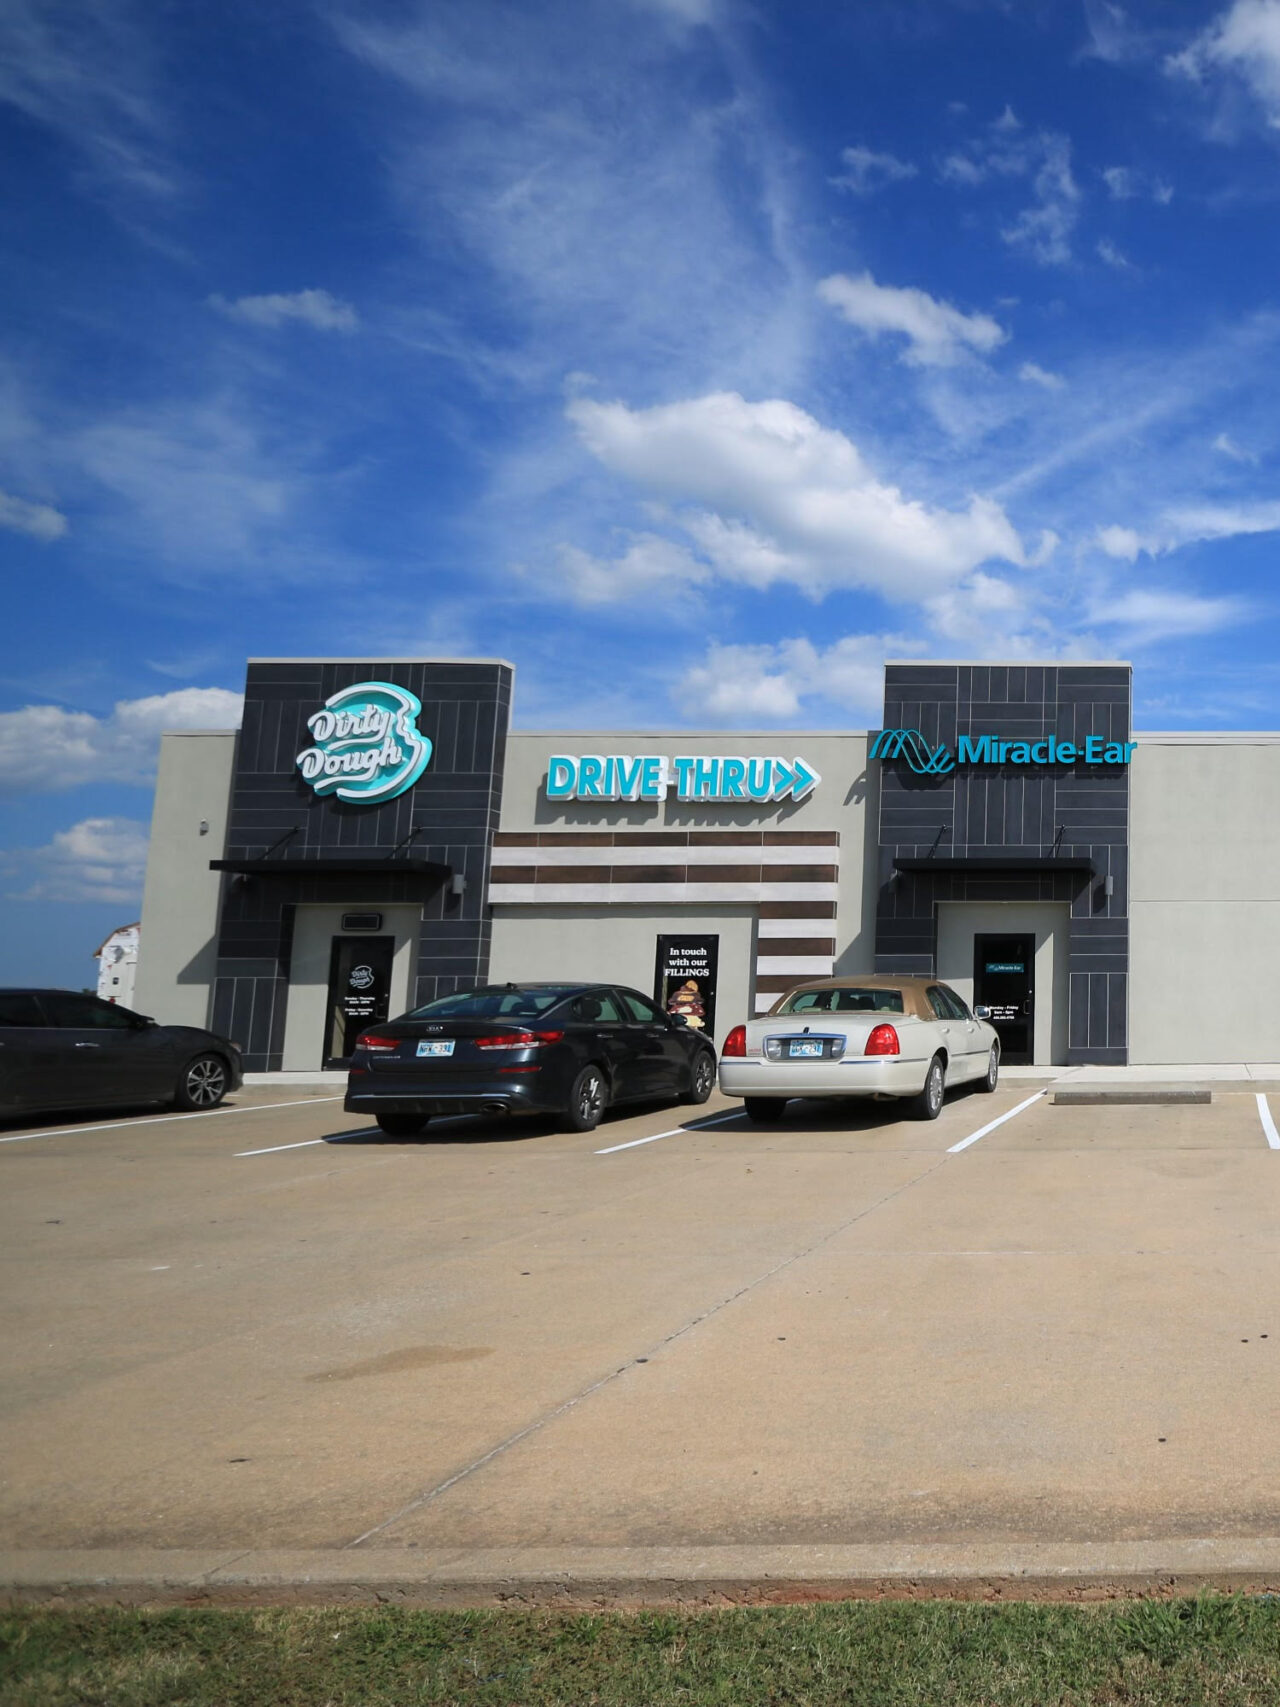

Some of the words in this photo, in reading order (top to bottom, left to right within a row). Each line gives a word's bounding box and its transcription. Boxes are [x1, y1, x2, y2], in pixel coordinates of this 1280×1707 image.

[307, 703, 395, 751] Dirty
[296, 736, 403, 790] Dough
[546, 755, 669, 801] DRIVE
[668, 958, 690, 966] with
[669, 947, 680, 956] In
[681, 947, 707, 956] touch
[664, 968, 710, 977] FILLINGS
